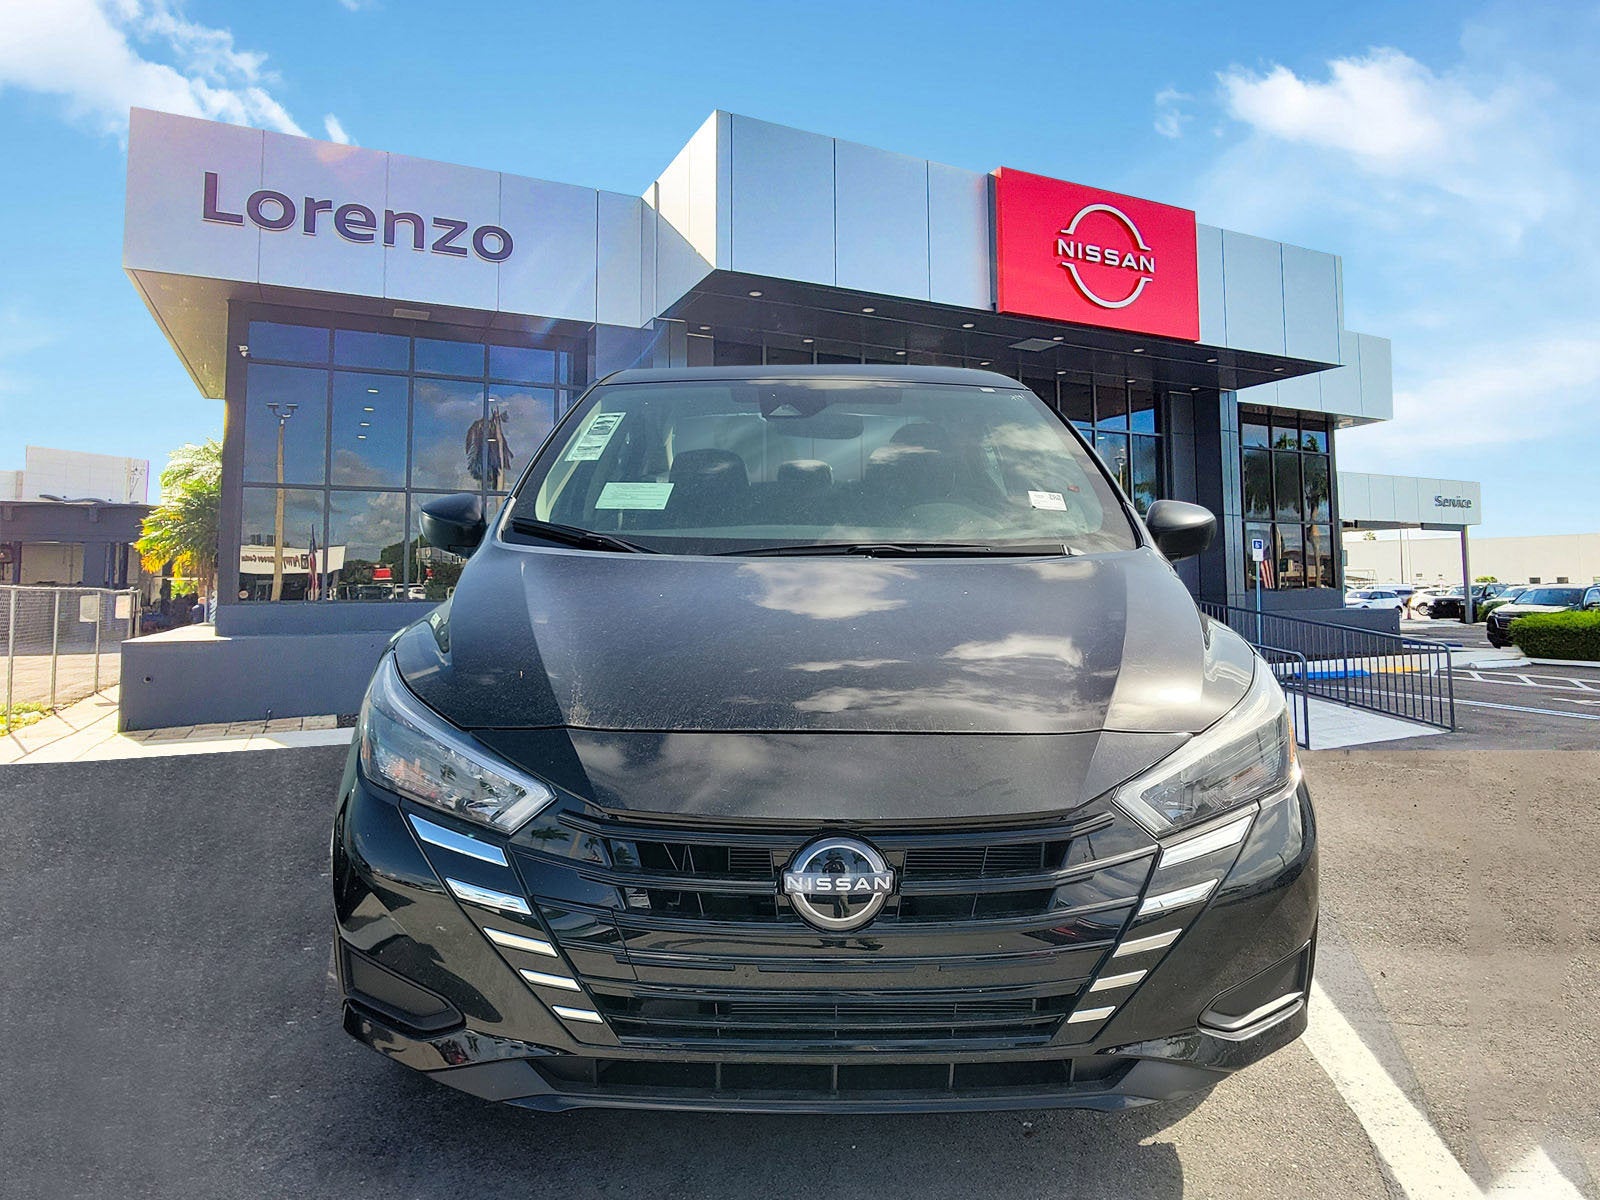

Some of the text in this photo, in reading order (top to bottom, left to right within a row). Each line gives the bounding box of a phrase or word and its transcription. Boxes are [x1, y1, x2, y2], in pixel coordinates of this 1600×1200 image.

[202, 171, 514, 263] Lorenzo
[1057, 238, 1155, 273] NISSAN
[1434, 495, 1472, 509] Service
[786, 876, 890, 892] NISSAN
